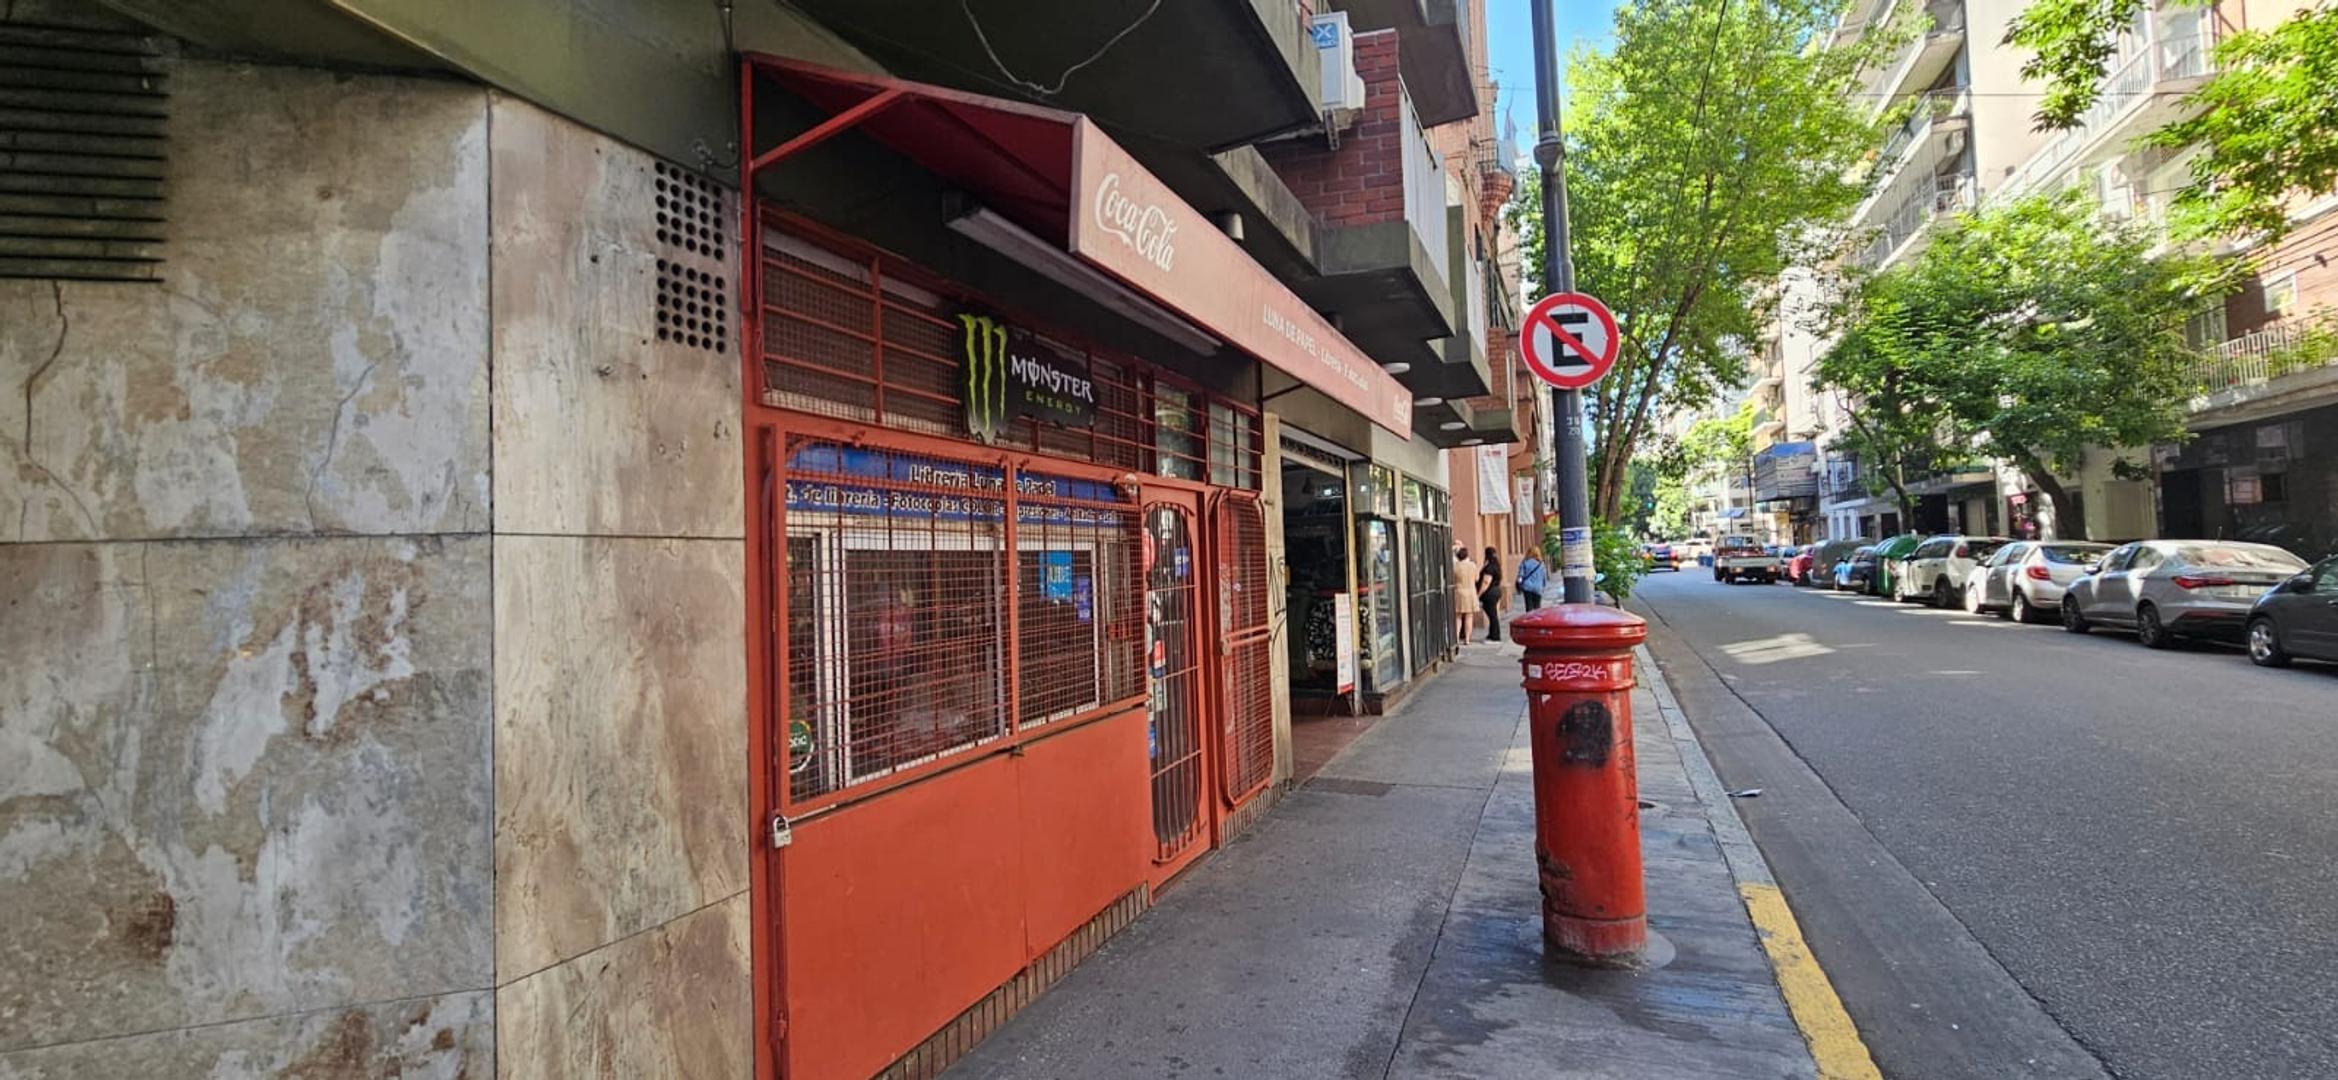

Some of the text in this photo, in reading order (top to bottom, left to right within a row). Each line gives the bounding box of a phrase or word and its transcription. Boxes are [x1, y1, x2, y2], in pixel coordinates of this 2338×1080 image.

[1550, 312, 1592, 368] E
[1010, 353, 1095, 404] MONSTER
[1025, 390, 1082, 416] ENERGY
